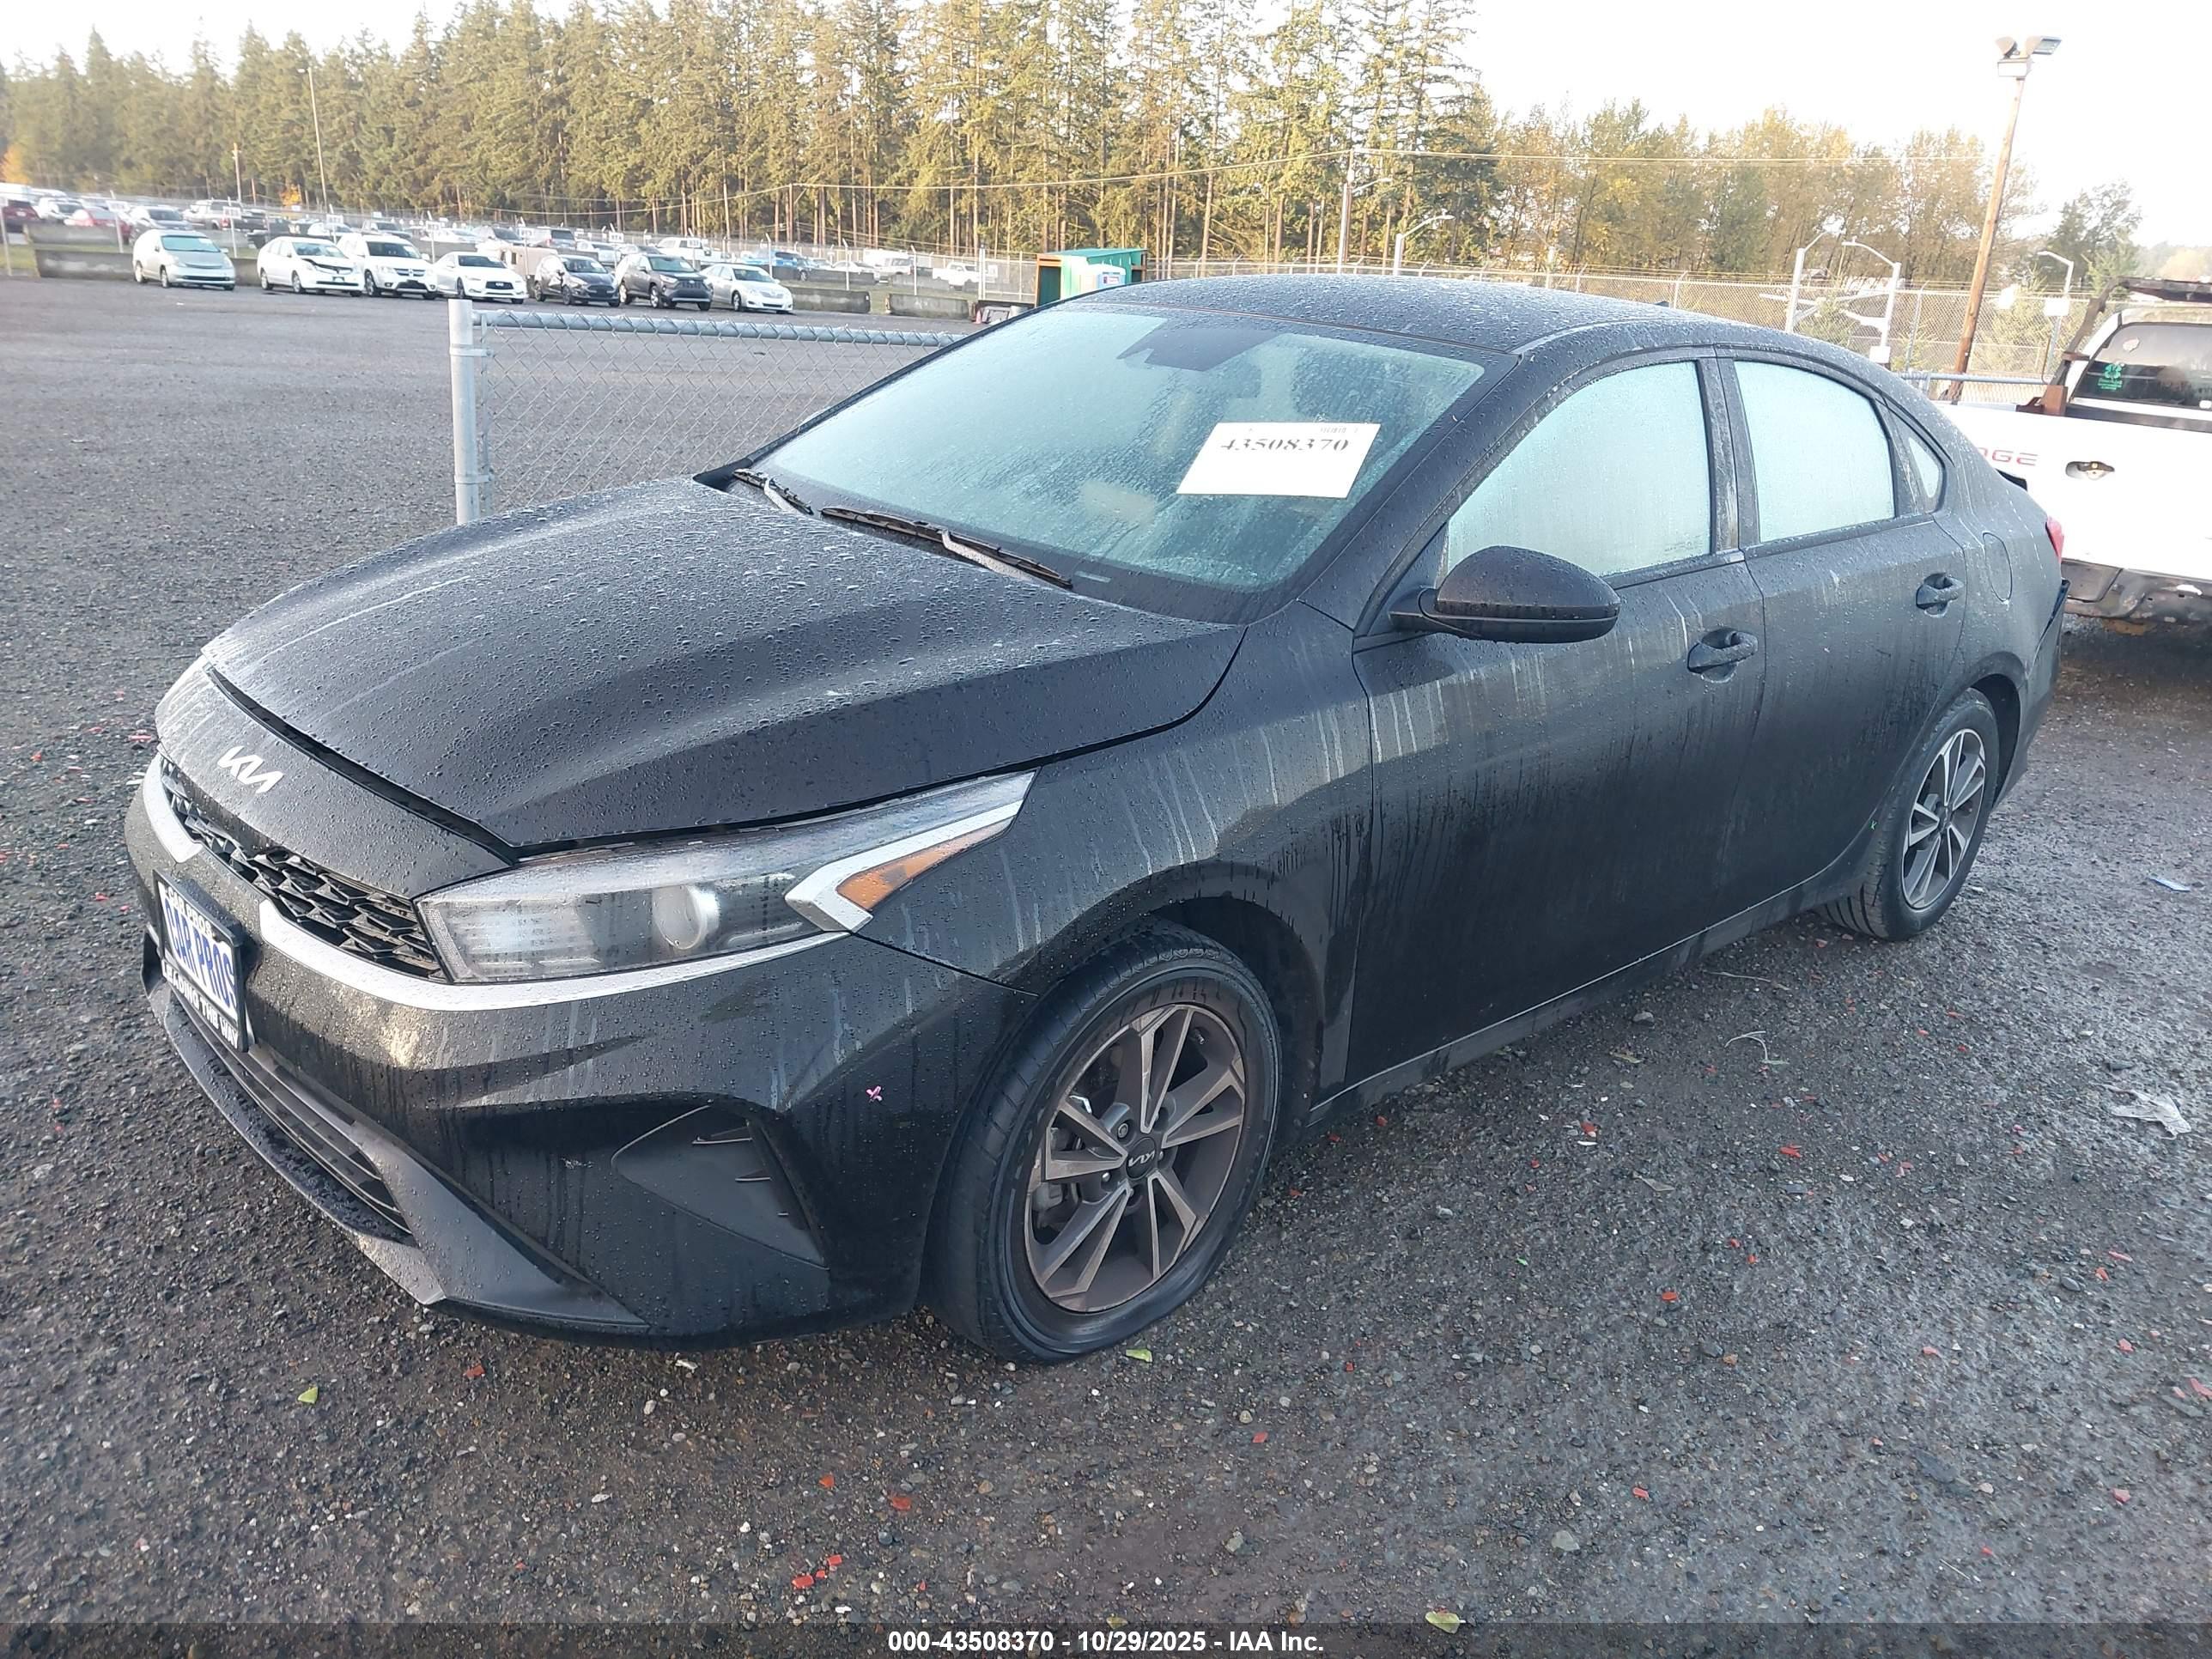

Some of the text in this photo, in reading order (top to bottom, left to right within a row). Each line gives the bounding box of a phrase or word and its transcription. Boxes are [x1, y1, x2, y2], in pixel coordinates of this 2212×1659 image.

[1220, 439, 1349, 452] 43508370
[165, 897, 237, 1008] CAR PROS
[185, 903, 214, 939] PROS
[161, 959, 239, 1049] LEADING THE WAY
